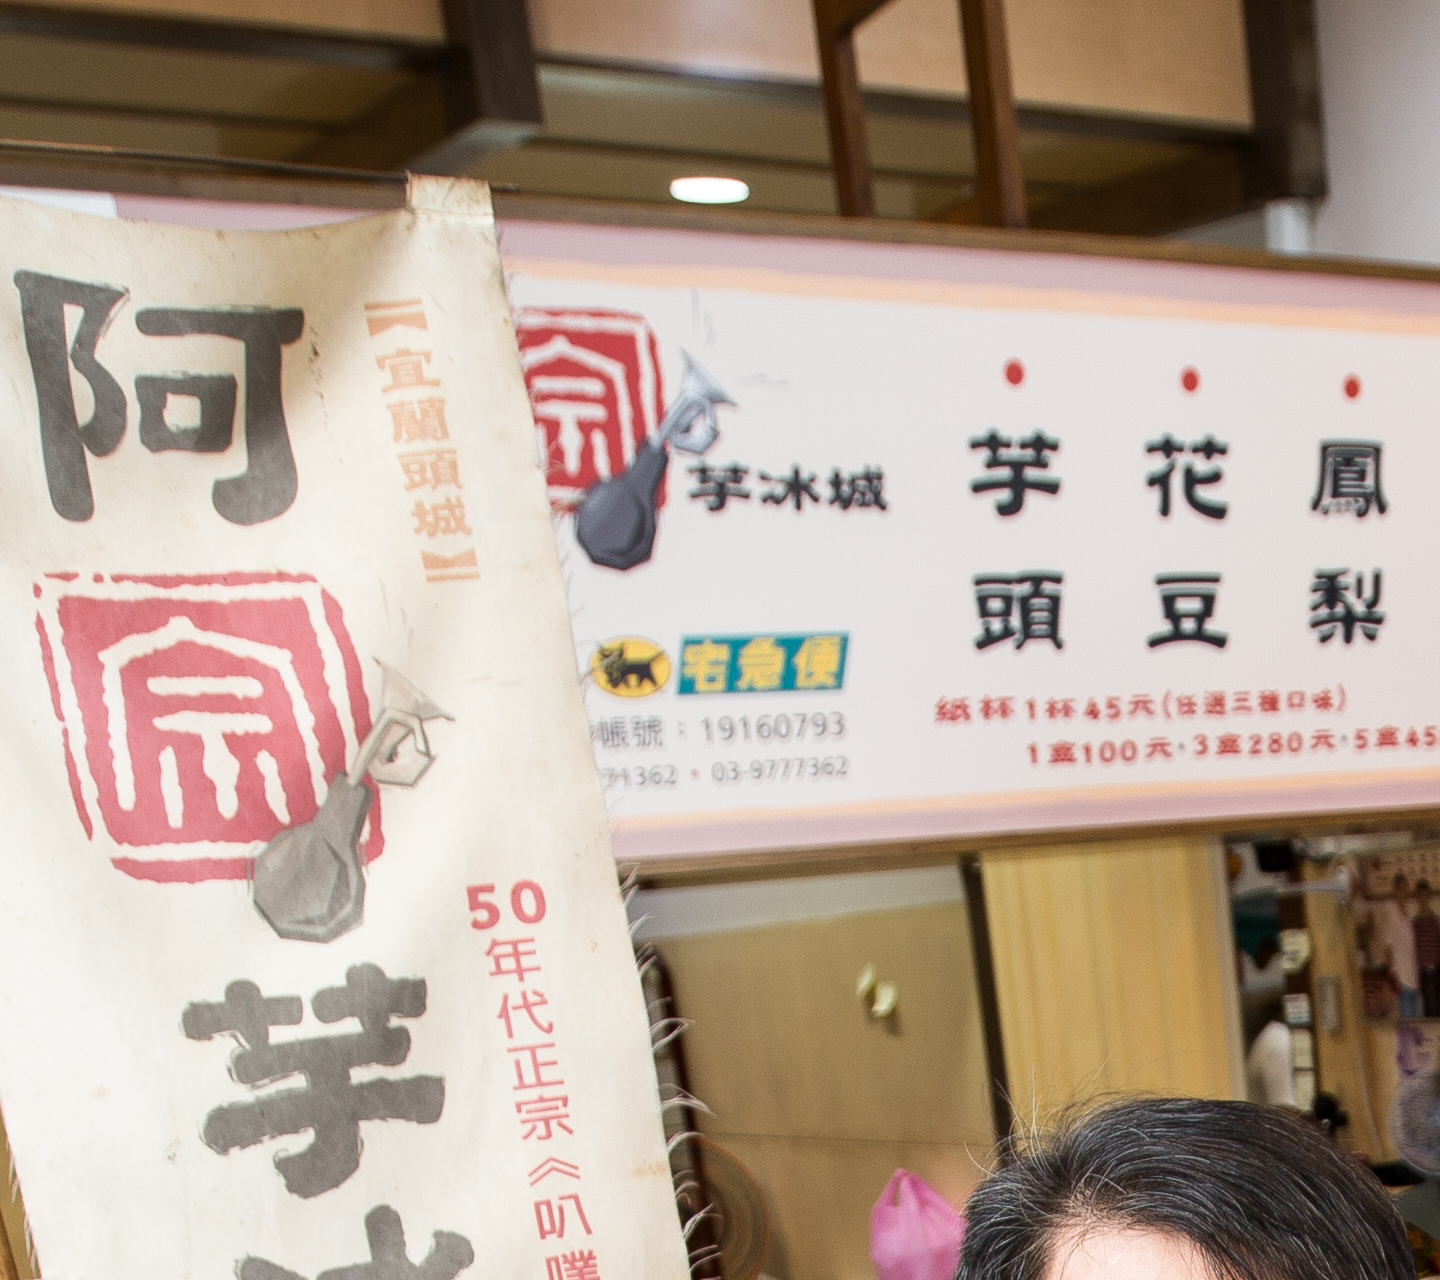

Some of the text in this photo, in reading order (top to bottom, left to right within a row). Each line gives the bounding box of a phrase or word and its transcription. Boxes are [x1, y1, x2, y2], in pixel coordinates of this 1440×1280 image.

[686, 460, 889, 512] 芋冰城
[682, 637, 843, 691] 宅急便
